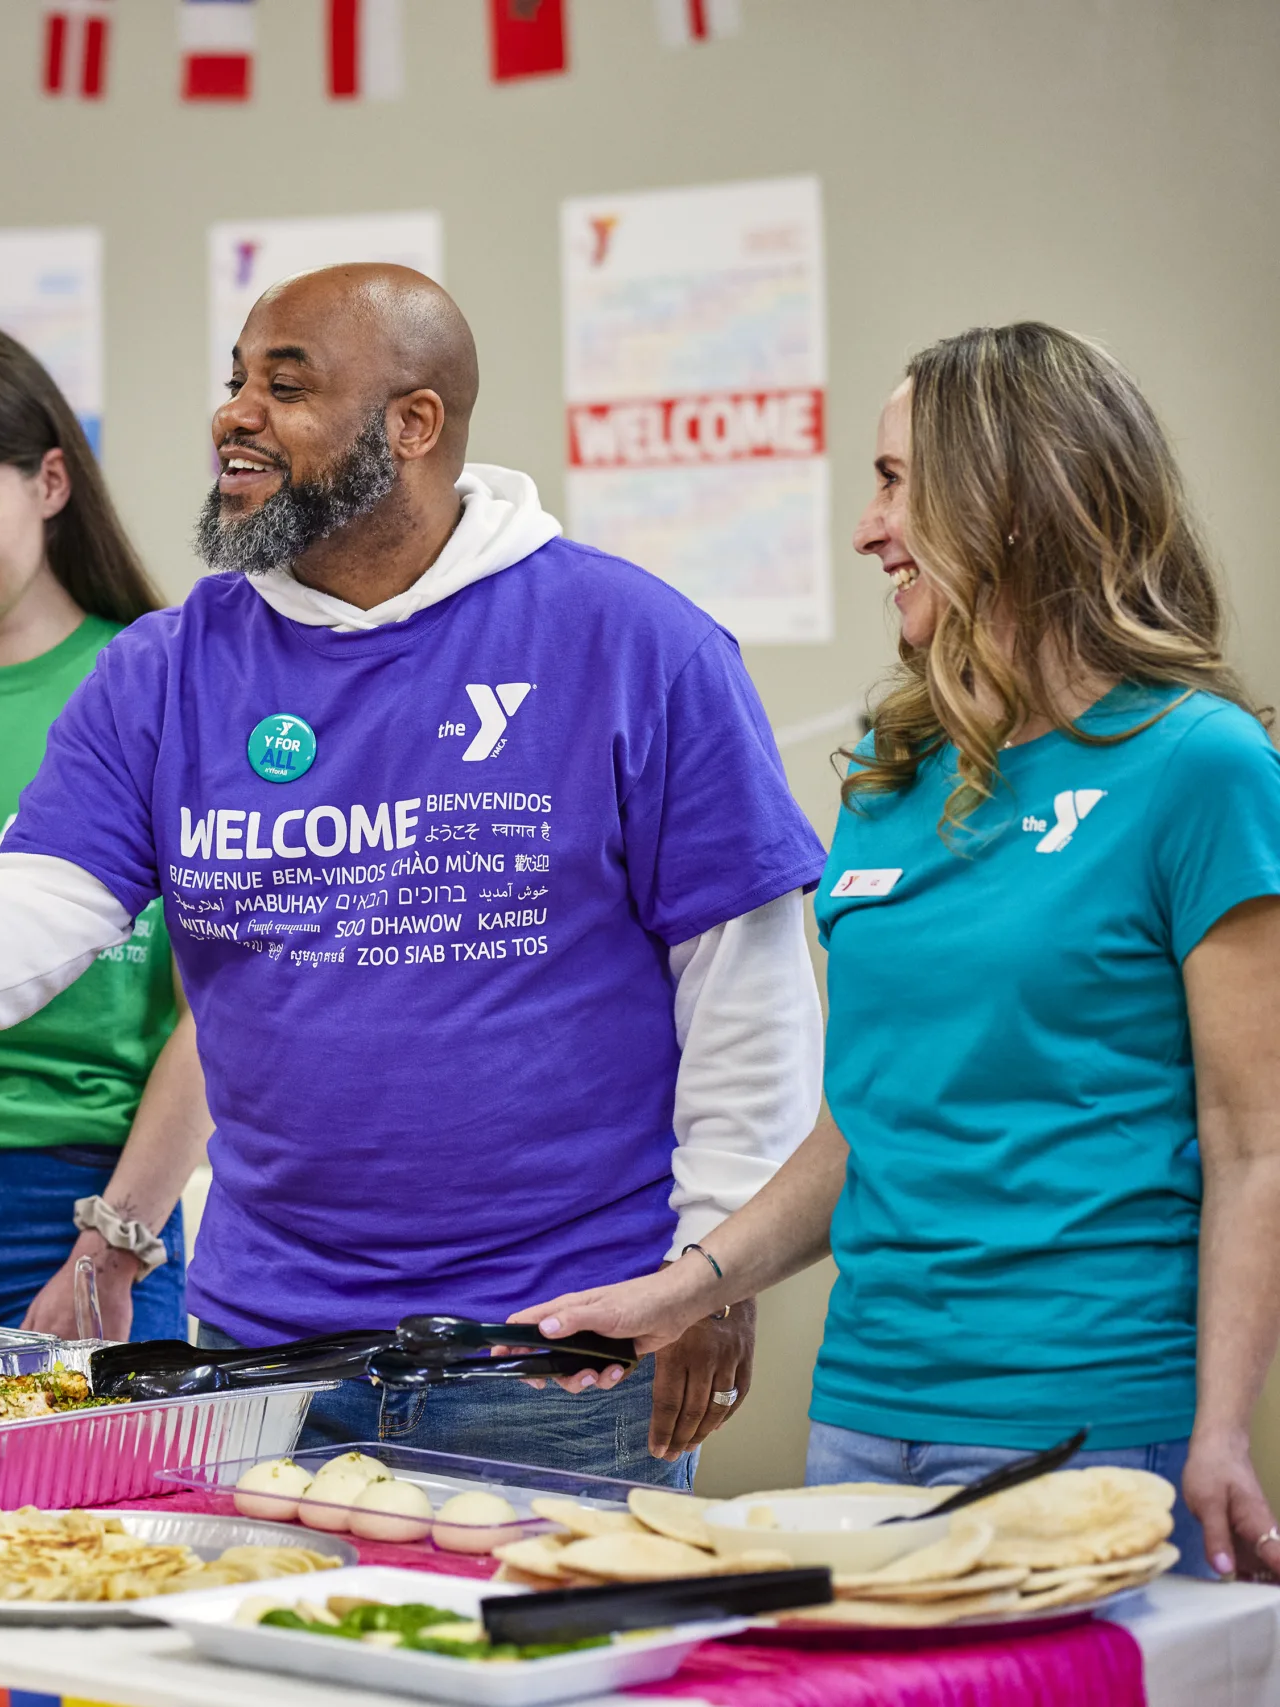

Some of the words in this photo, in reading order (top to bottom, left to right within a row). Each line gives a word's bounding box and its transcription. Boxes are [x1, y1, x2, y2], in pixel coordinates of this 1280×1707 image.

[575, 393, 819, 465] WELCOME
[438, 721, 466, 738] the
[264, 735, 274, 747] Y
[275, 737, 301, 752] FOR
[490, 738, 508, 759] YMCA
[260, 748, 296, 771] ALL
[426, 792, 552, 813] BIENVENIDOS
[180, 797, 421, 860] WELCOME
[425, 823, 480, 843] ようこそ
[491, 823, 537, 838] स्वागत
[540, 821, 552, 842] है
[1022, 815, 1047, 832] the
[170, 865, 263, 890] BIENVENUE
[272, 863, 386, 886] BEM-VINDOS
[391, 850, 439, 877] CHÀO
[445, 850, 505, 873] MỪNG
[514, 853, 550, 873] 歡迎
[335, 889, 388, 911] הבאים
[398, 885, 467, 905] ברוכים
[517, 885, 549, 900] خوش
[235, 894, 329, 915] MABUHAY
[178, 913, 240, 941] WITAMY
[334, 919, 365, 938] SOO
[371, 914, 462, 936] DHAWOW
[478, 907, 548, 931] KARIBU
[357, 946, 399, 966] ZOO
[404, 944, 446, 964] SIAB
[450, 940, 507, 962] TXAIS
[511, 935, 548, 956] TOS
